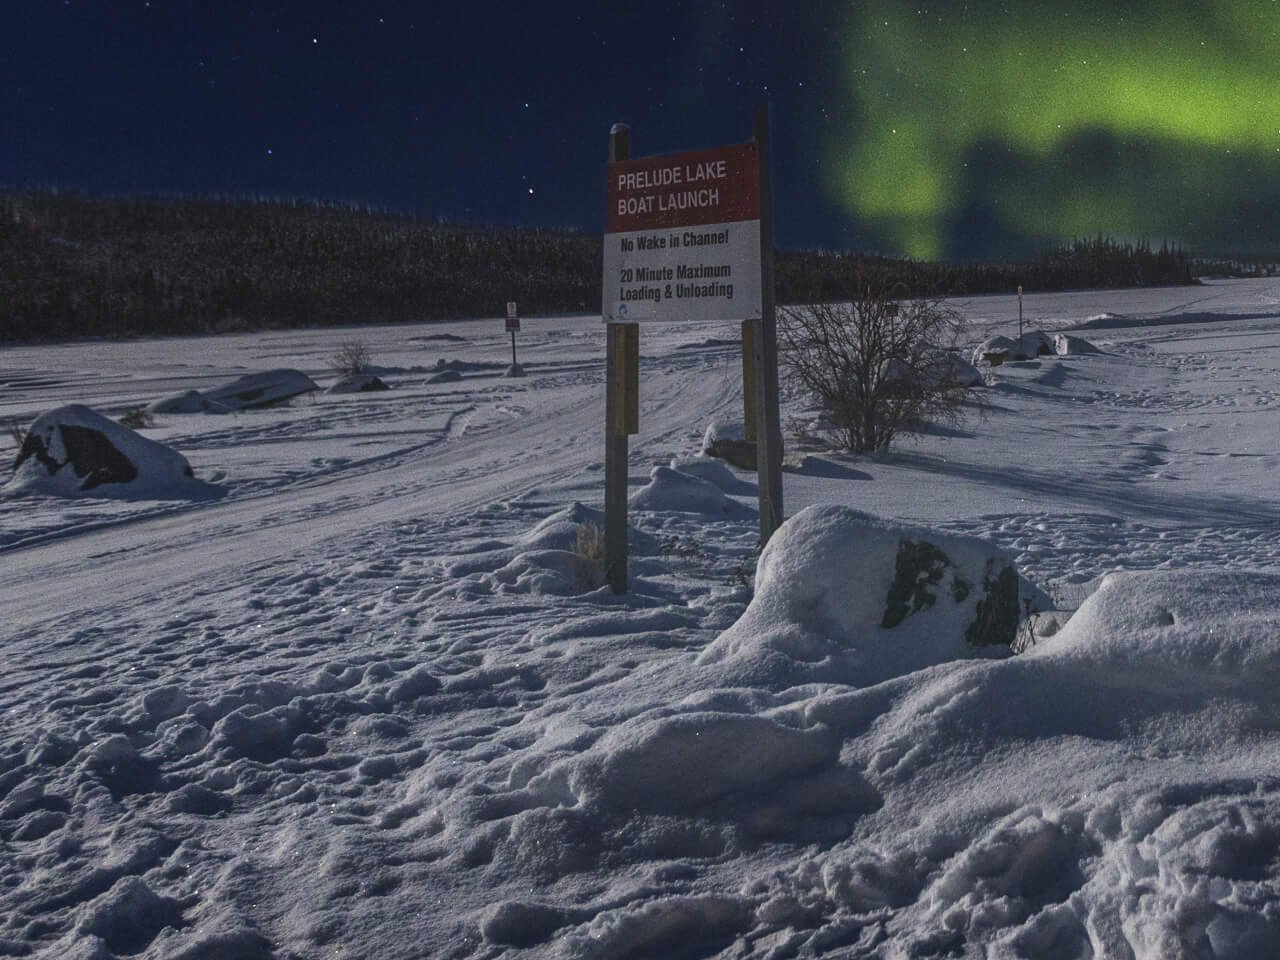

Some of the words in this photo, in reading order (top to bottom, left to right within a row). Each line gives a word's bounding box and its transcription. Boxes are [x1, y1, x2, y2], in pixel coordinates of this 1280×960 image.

[618, 167, 682, 191] PRELUDE
[686, 161, 726, 182] LAKE
[618, 196, 654, 215] BOAT
[660, 189, 719, 211] LAUNCH
[621, 238, 633, 252] No
[637, 235, 665, 251] Wake
[670, 234, 679, 248] in
[683, 229, 729, 247] Channel
[620, 269, 633, 283] 20
[636, 267, 673, 282] Minute
[677, 264, 731, 279] Maximum
[620, 286, 660, 302] Loading
[665, 285, 672, 298] &
[677, 283, 733, 299] Unloading
